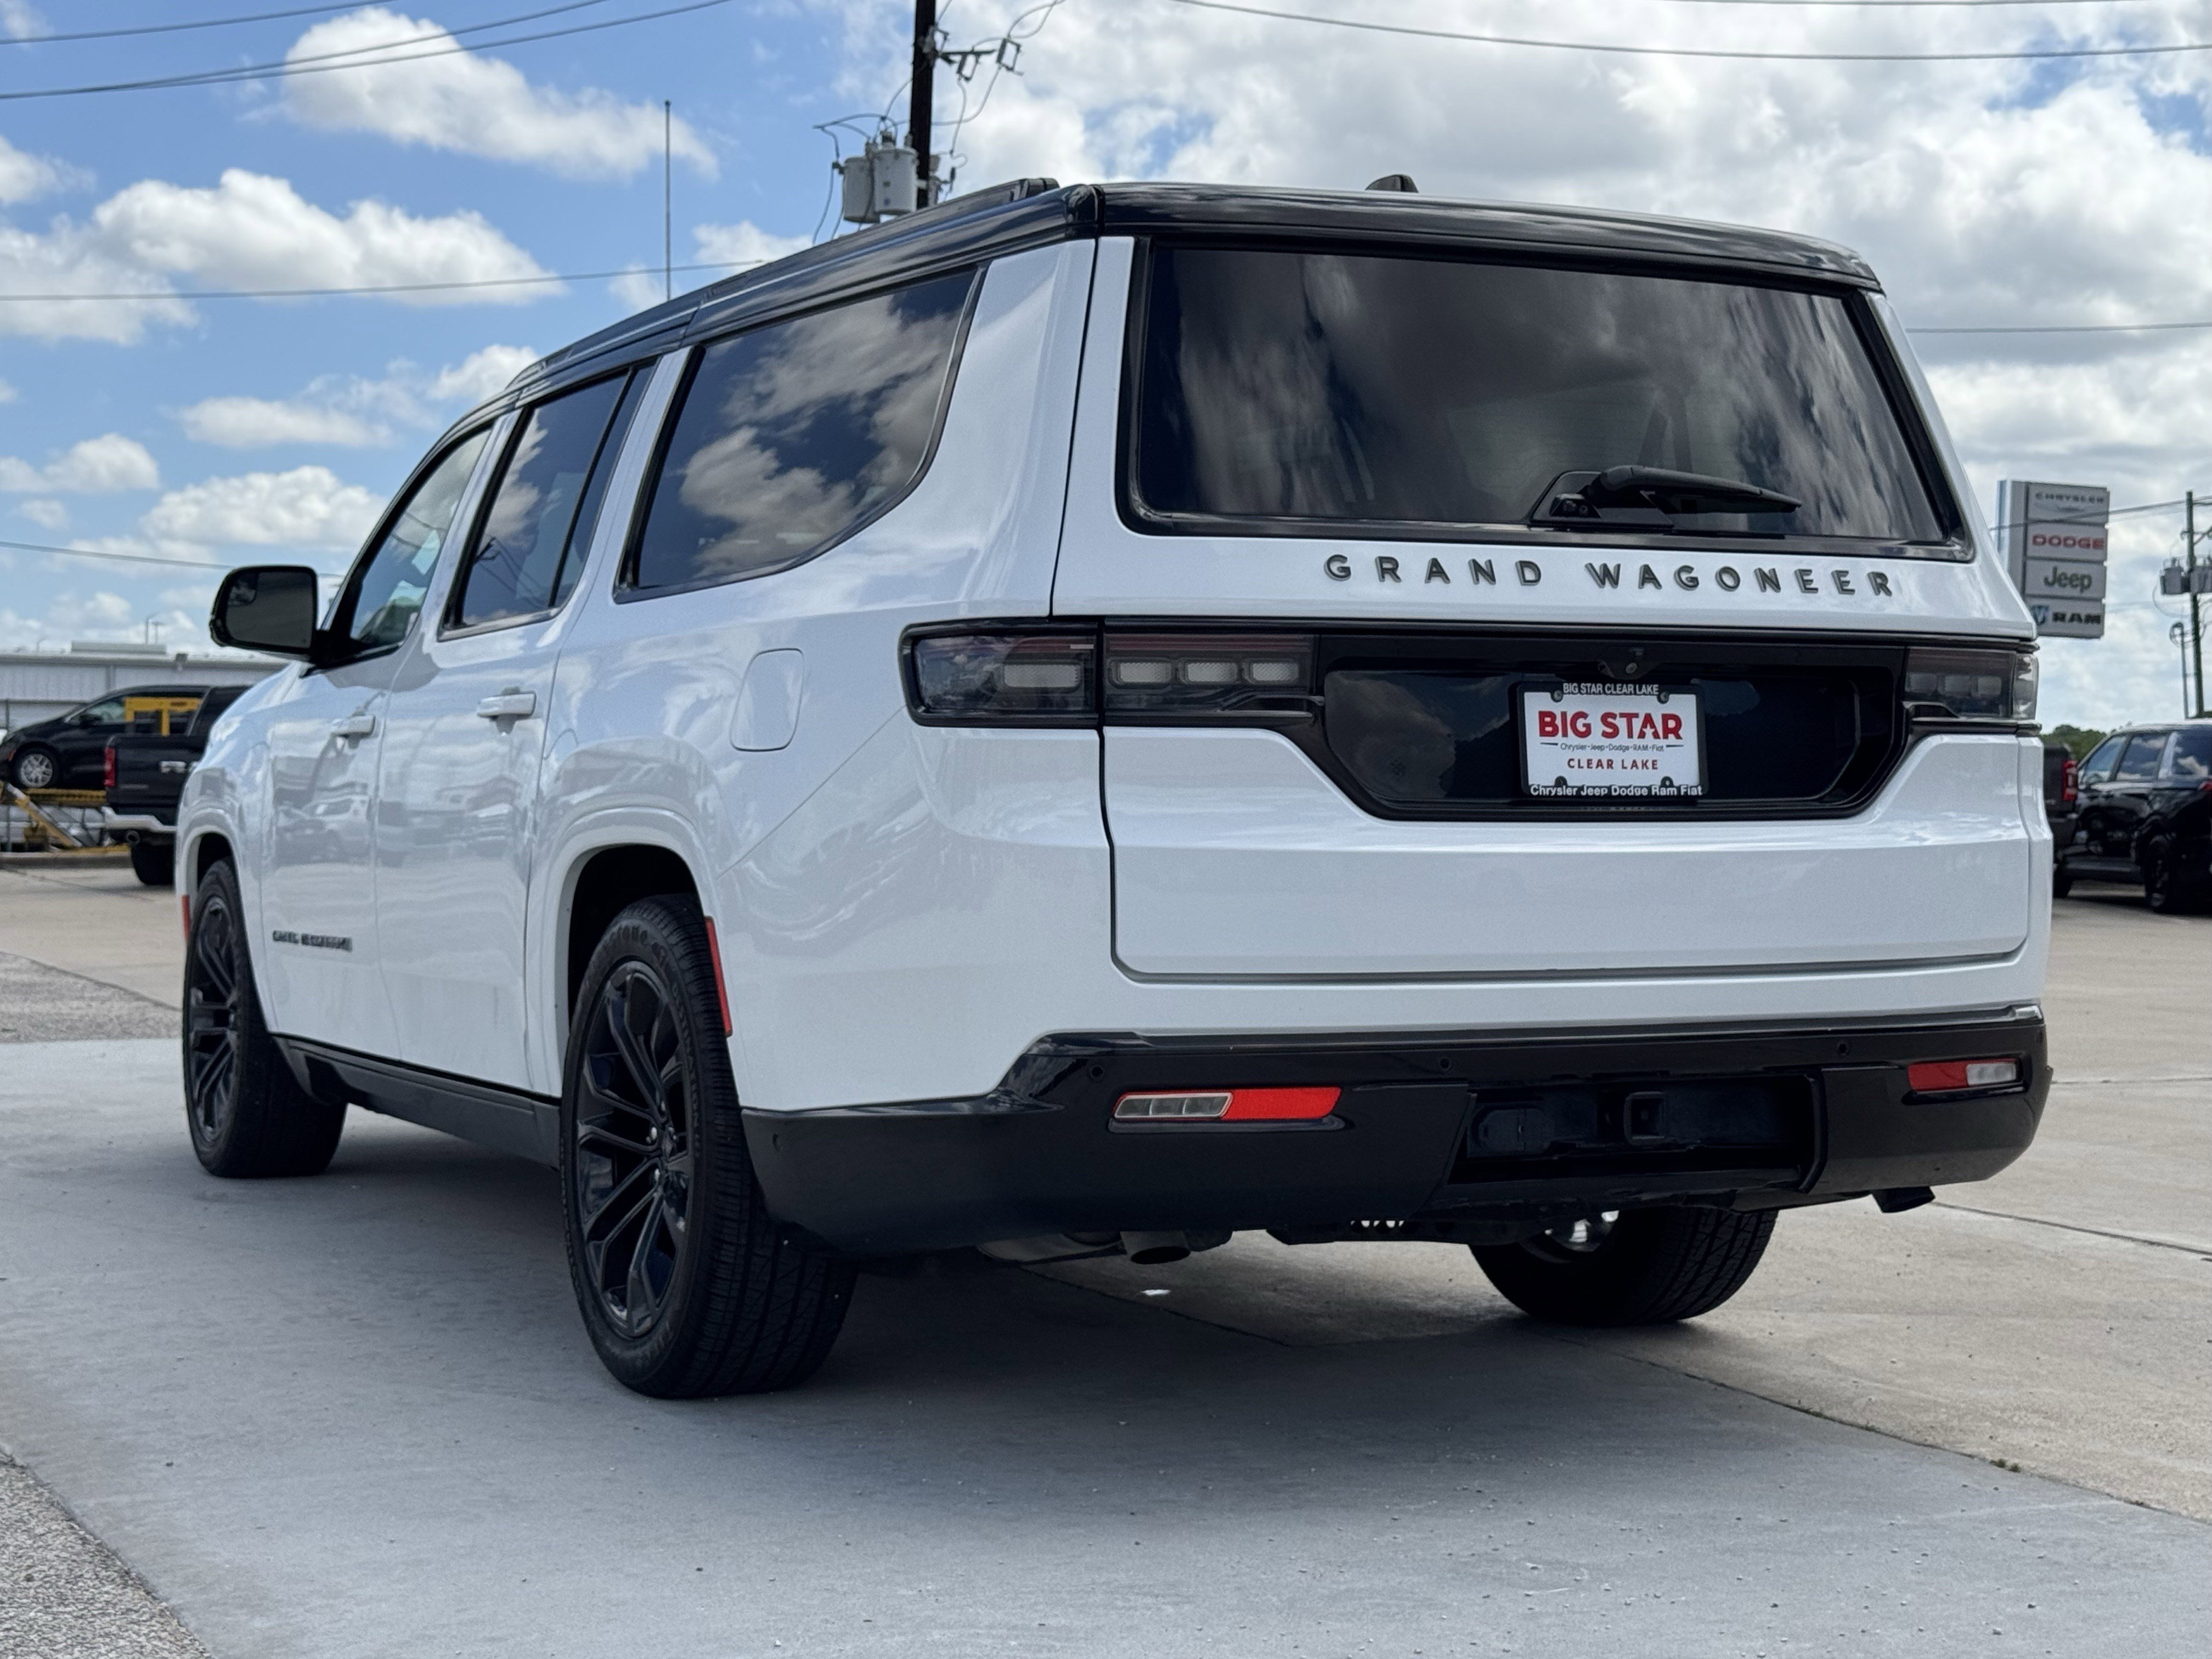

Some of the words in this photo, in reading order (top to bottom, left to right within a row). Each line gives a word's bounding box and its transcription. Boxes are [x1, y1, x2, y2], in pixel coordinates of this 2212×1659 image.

[2032, 534, 2103, 549] DODGE
[1324, 554, 1542, 586] GRAND
[1585, 562, 1893, 596] WAGONEER
[2044, 566, 2092, 594] Jeep
[2052, 611, 2101, 624] RAM
[1563, 682, 1578, 693] BIG
[1580, 683, 1603, 694] STAR
[1605, 684, 1634, 694] CLEAR
[1636, 684, 1659, 695] LAKE
[1538, 710, 1592, 738] BIG
[1600, 712, 1683, 740] STAR
[1567, 758, 1614, 769] CLEAR
[1621, 759, 1658, 770] LAKE
[1530, 785, 1577, 795] Chrysler
[1581, 786, 1608, 795] Jeep
[1611, 786, 1648, 795] Dodge
[1651, 786, 1677, 795] Ram
[1680, 786, 1702, 795] Fiat
